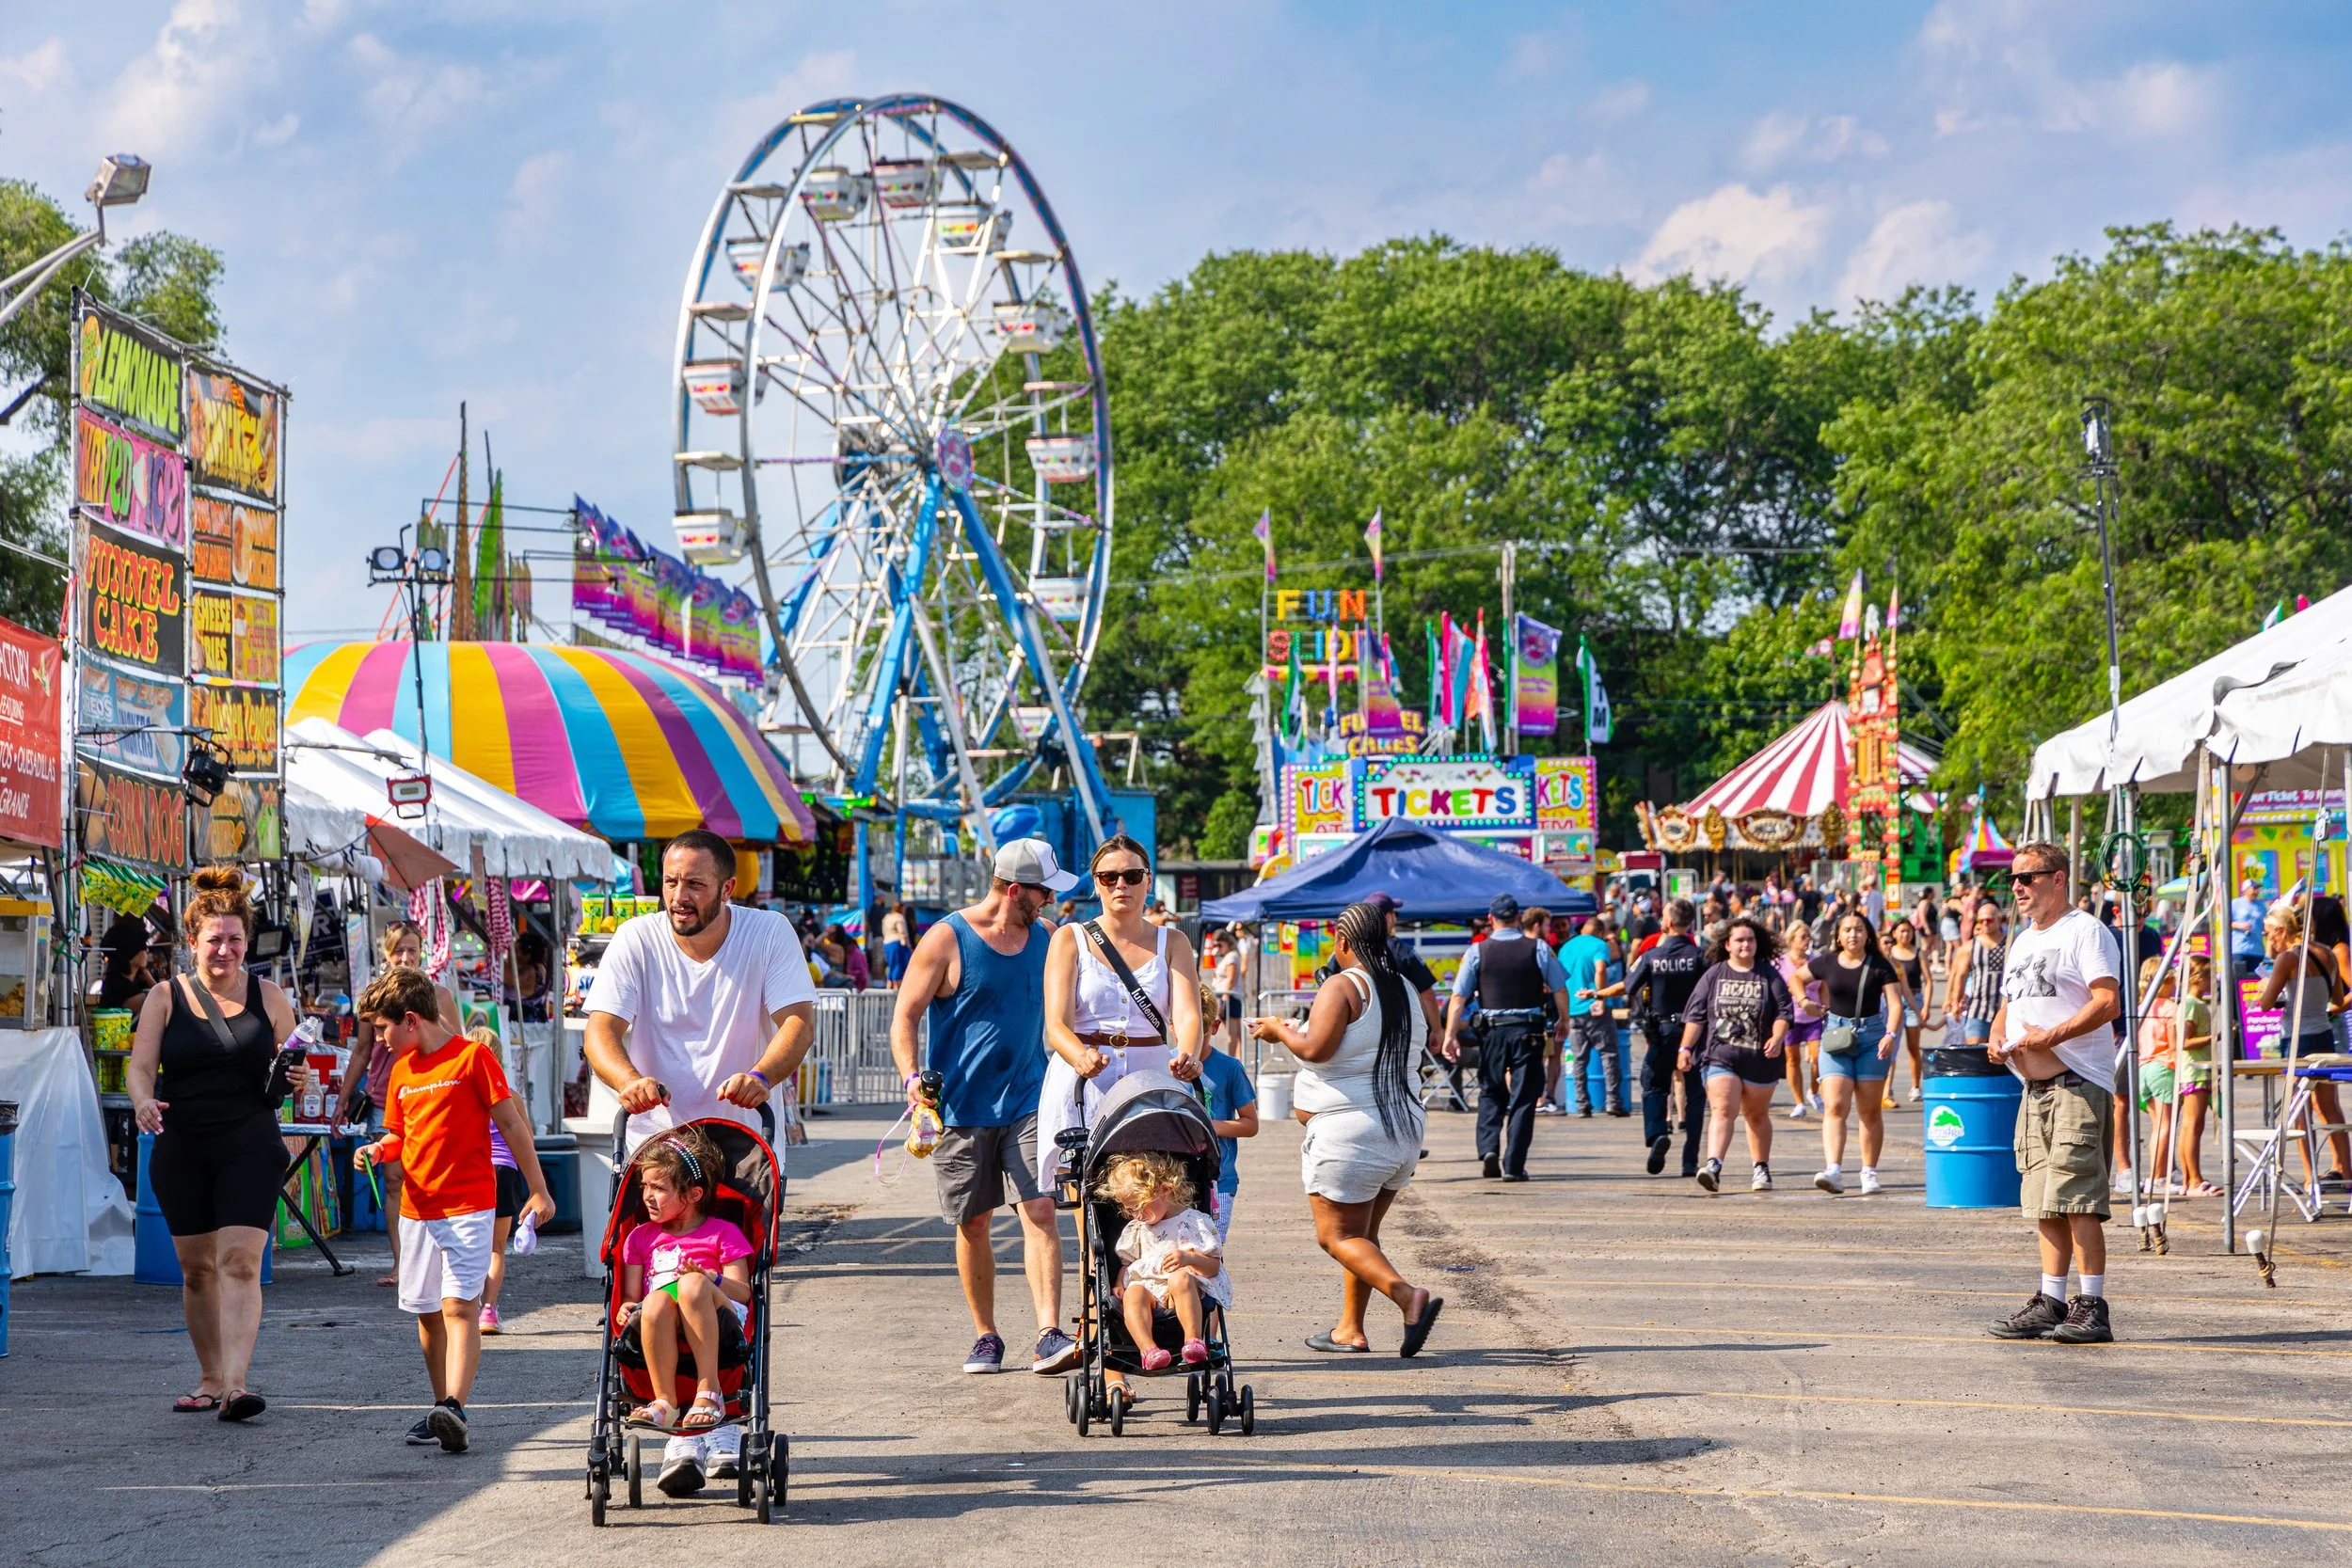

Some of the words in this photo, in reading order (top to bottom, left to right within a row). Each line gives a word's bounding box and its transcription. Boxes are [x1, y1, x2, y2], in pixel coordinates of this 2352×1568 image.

[93, 327, 180, 436] LEMONADE
[86, 534, 180, 616] FUNNEL
[1277, 589, 1367, 622] FUN
[94, 594, 159, 664] CAKE
[1339, 710, 1426, 737] FUEL
[1372, 785, 1517, 816] TICKETS
[104, 773, 147, 860] CORN
[148, 787, 184, 867] DOG
[1652, 958, 1694, 973] POLICE
[1131, 988, 1161, 1028] lululemon
[398, 1079, 461, 1100] Champion
